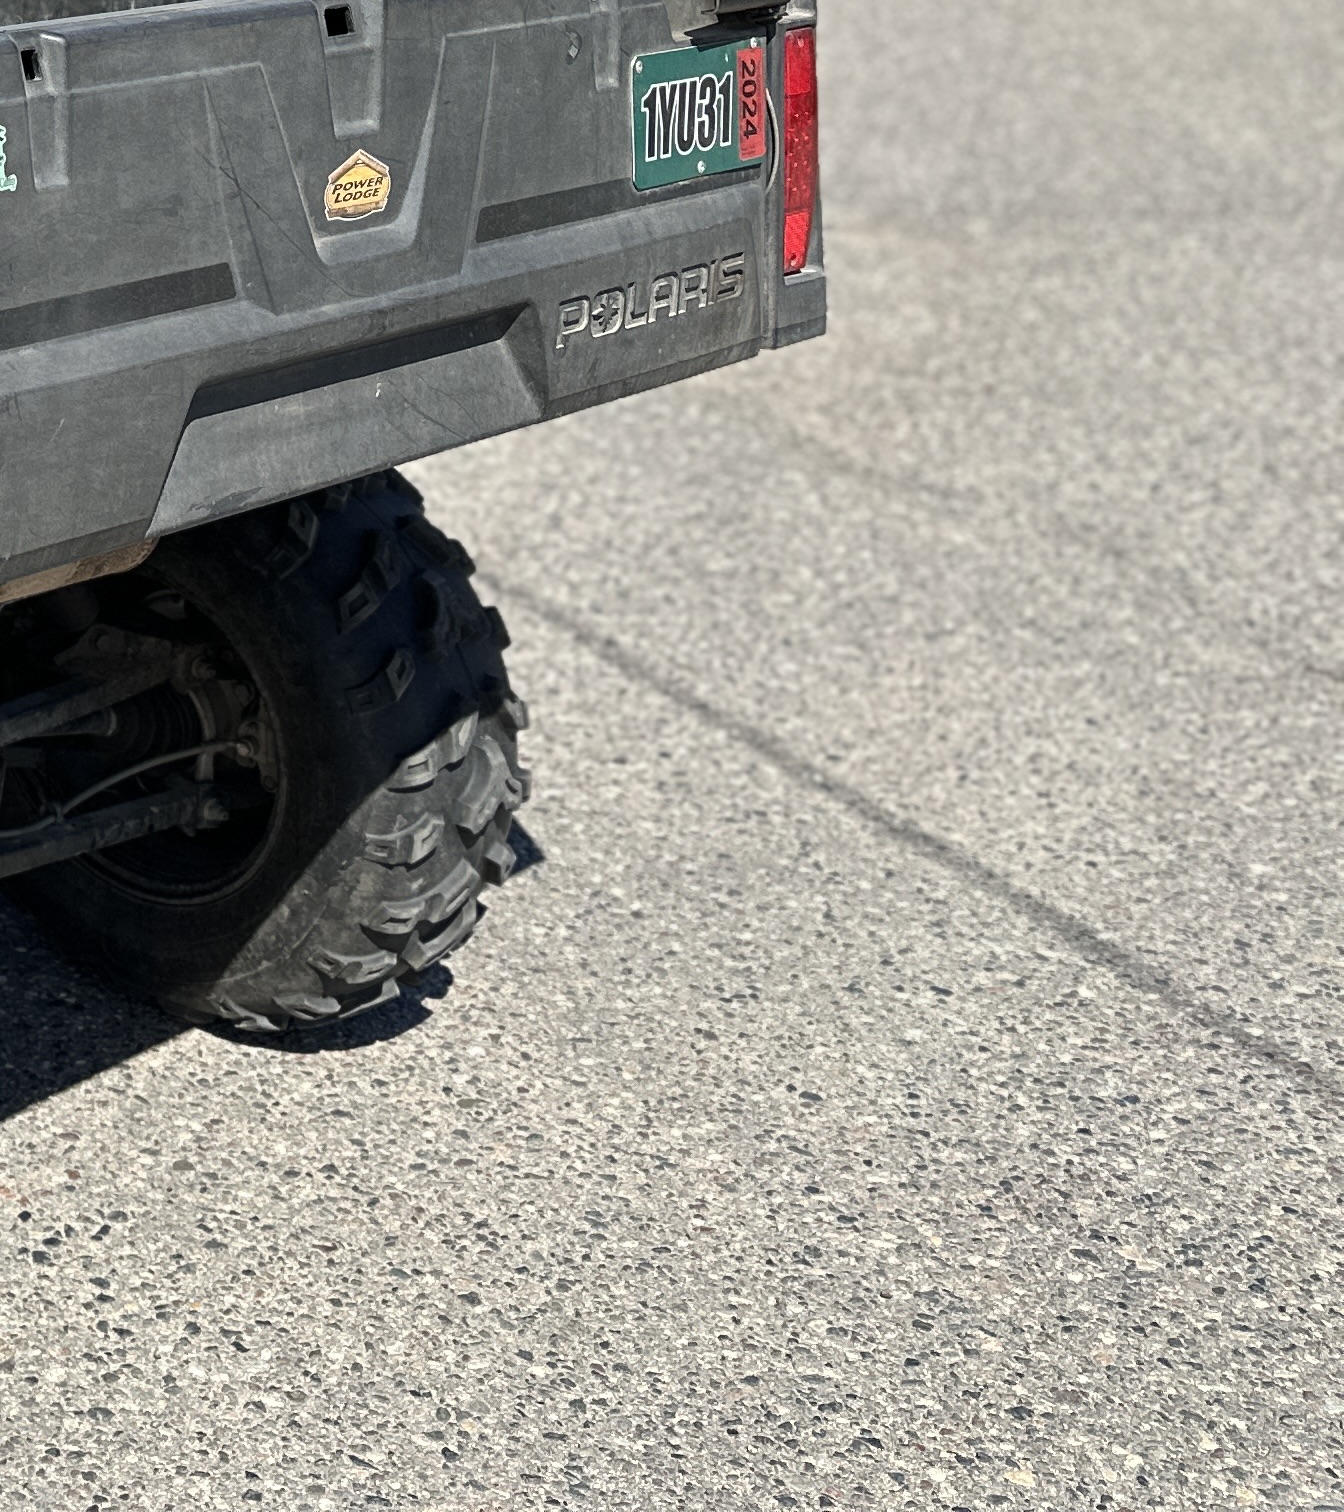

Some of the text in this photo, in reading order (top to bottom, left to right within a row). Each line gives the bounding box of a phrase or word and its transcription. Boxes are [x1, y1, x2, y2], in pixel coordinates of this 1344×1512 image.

[640, 71, 734, 163] 1YU31
[741, 58, 758, 140] 2024
[332, 176, 384, 195] POWER
[334, 187, 381, 204] LODGE
[555, 251, 745, 349] POLARIS
